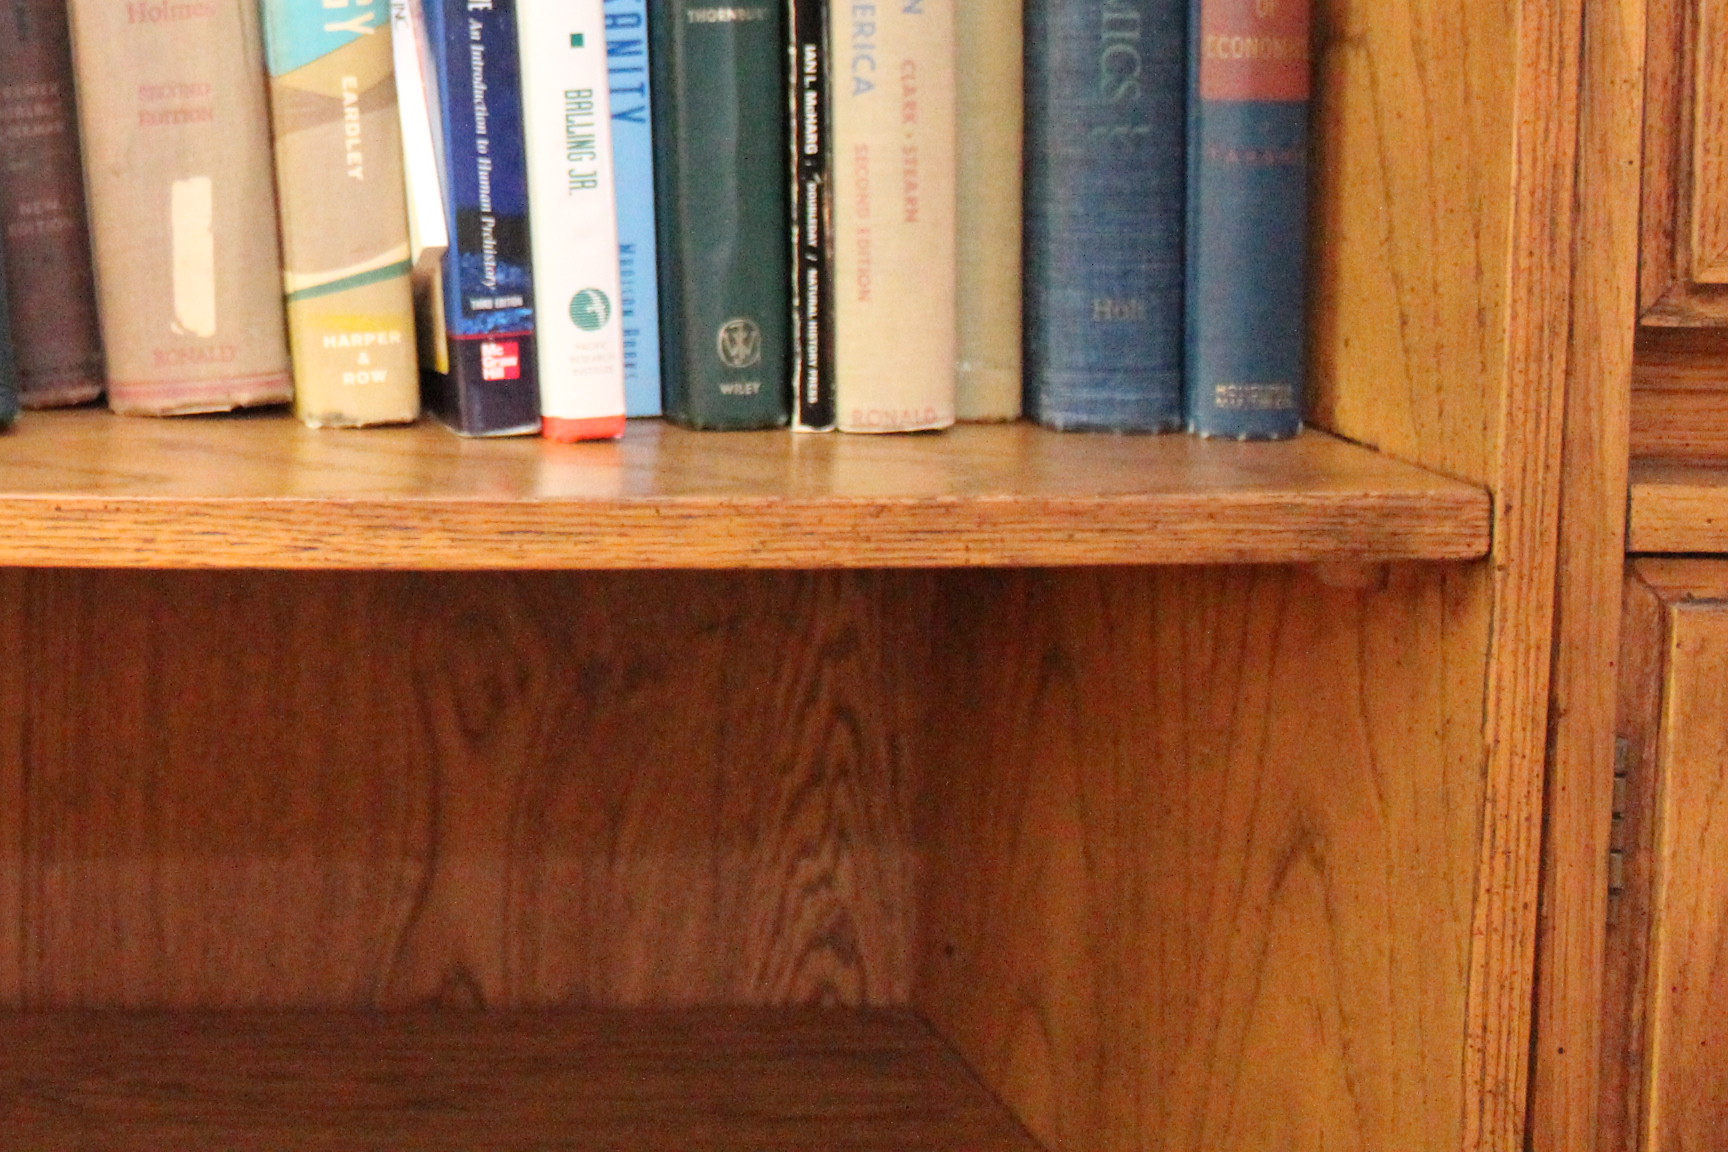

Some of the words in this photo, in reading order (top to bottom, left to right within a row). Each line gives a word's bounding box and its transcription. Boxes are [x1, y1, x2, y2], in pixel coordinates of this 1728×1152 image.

[467, 18, 484, 39] An
[804, 44, 817, 73] IAN
[469, 44, 490, 133] Introduction
[901, 58, 918, 125] CLARK
[340, 75, 364, 181] EARDLEY
[475, 138, 490, 153] to
[564, 88, 597, 162] BALLING
[804, 89, 818, 154] McHARG
[477, 157, 494, 212] Human
[854, 144, 871, 219] SECOND
[806, 181, 818, 247] DOUBLEDAY
[479, 215, 498, 290] Prehistory
[856, 227, 872, 303] EDITION
[807, 267, 818, 318] NATURAL
[322, 330, 402, 348] HARPER
[807, 319, 818, 367] HISTORY
[343, 370, 388, 386] ROW
[719, 382, 762, 395] WILEY
